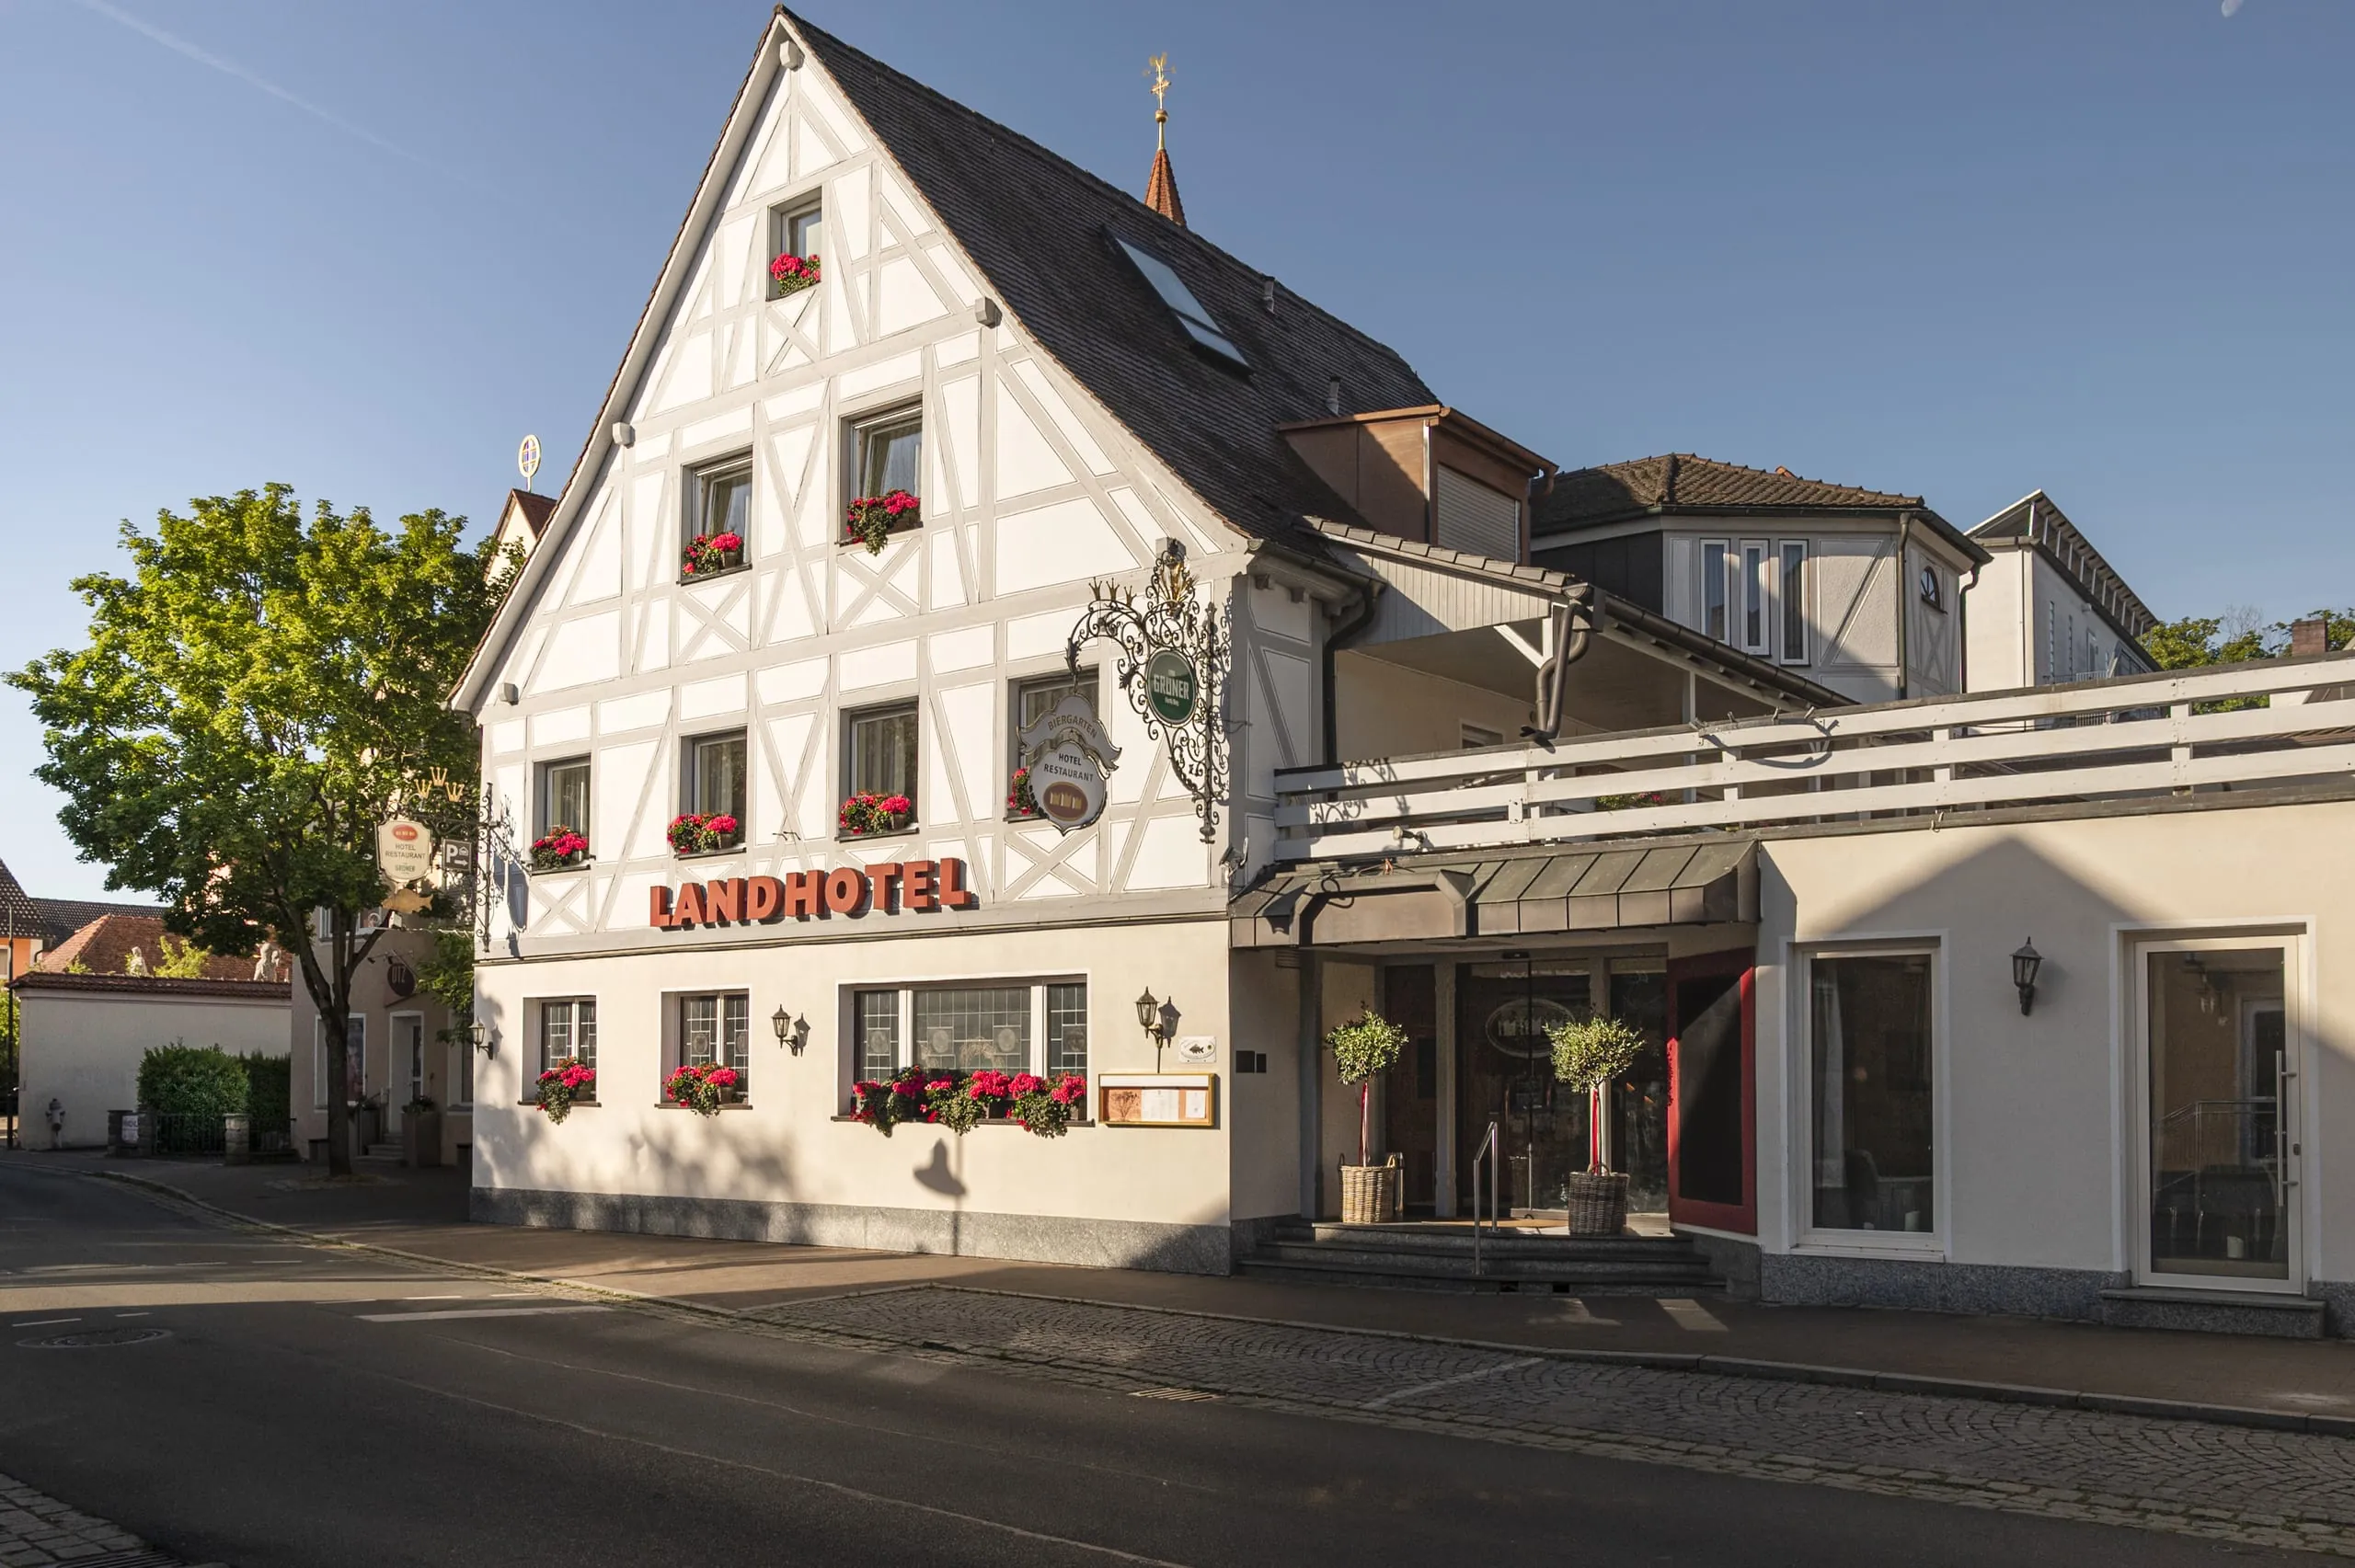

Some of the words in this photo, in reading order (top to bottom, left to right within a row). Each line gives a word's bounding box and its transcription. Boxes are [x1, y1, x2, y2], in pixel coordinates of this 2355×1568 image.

[1048, 715, 1097, 738] BIERGARTEN
[1059, 753, 1082, 766] HOTEL
[1043, 763, 1094, 783] RESTAURANT
[385, 850, 426, 859] RESTAURANT
[446, 844, 458, 863] P
[649, 857, 971, 928] LANDHOTEL
